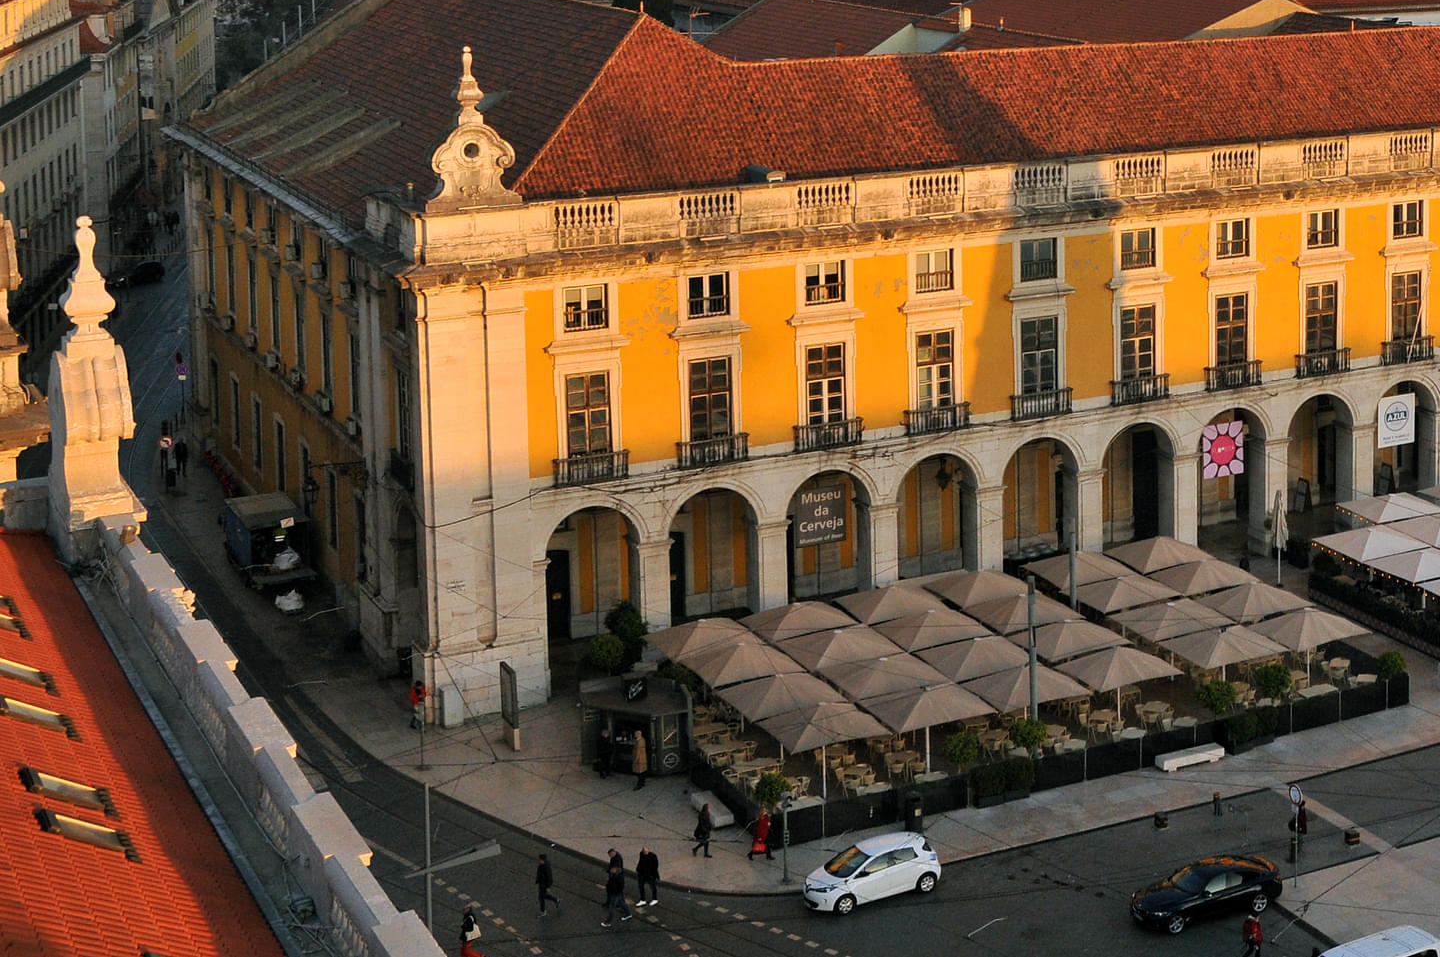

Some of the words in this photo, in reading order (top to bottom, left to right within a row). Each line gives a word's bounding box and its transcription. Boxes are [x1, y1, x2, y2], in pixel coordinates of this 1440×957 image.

[1387, 410, 1406, 422] AZUL
[801, 490, 841, 504] Museu
[814, 505, 829, 516] da
[799, 516, 844, 533] Cerveja
